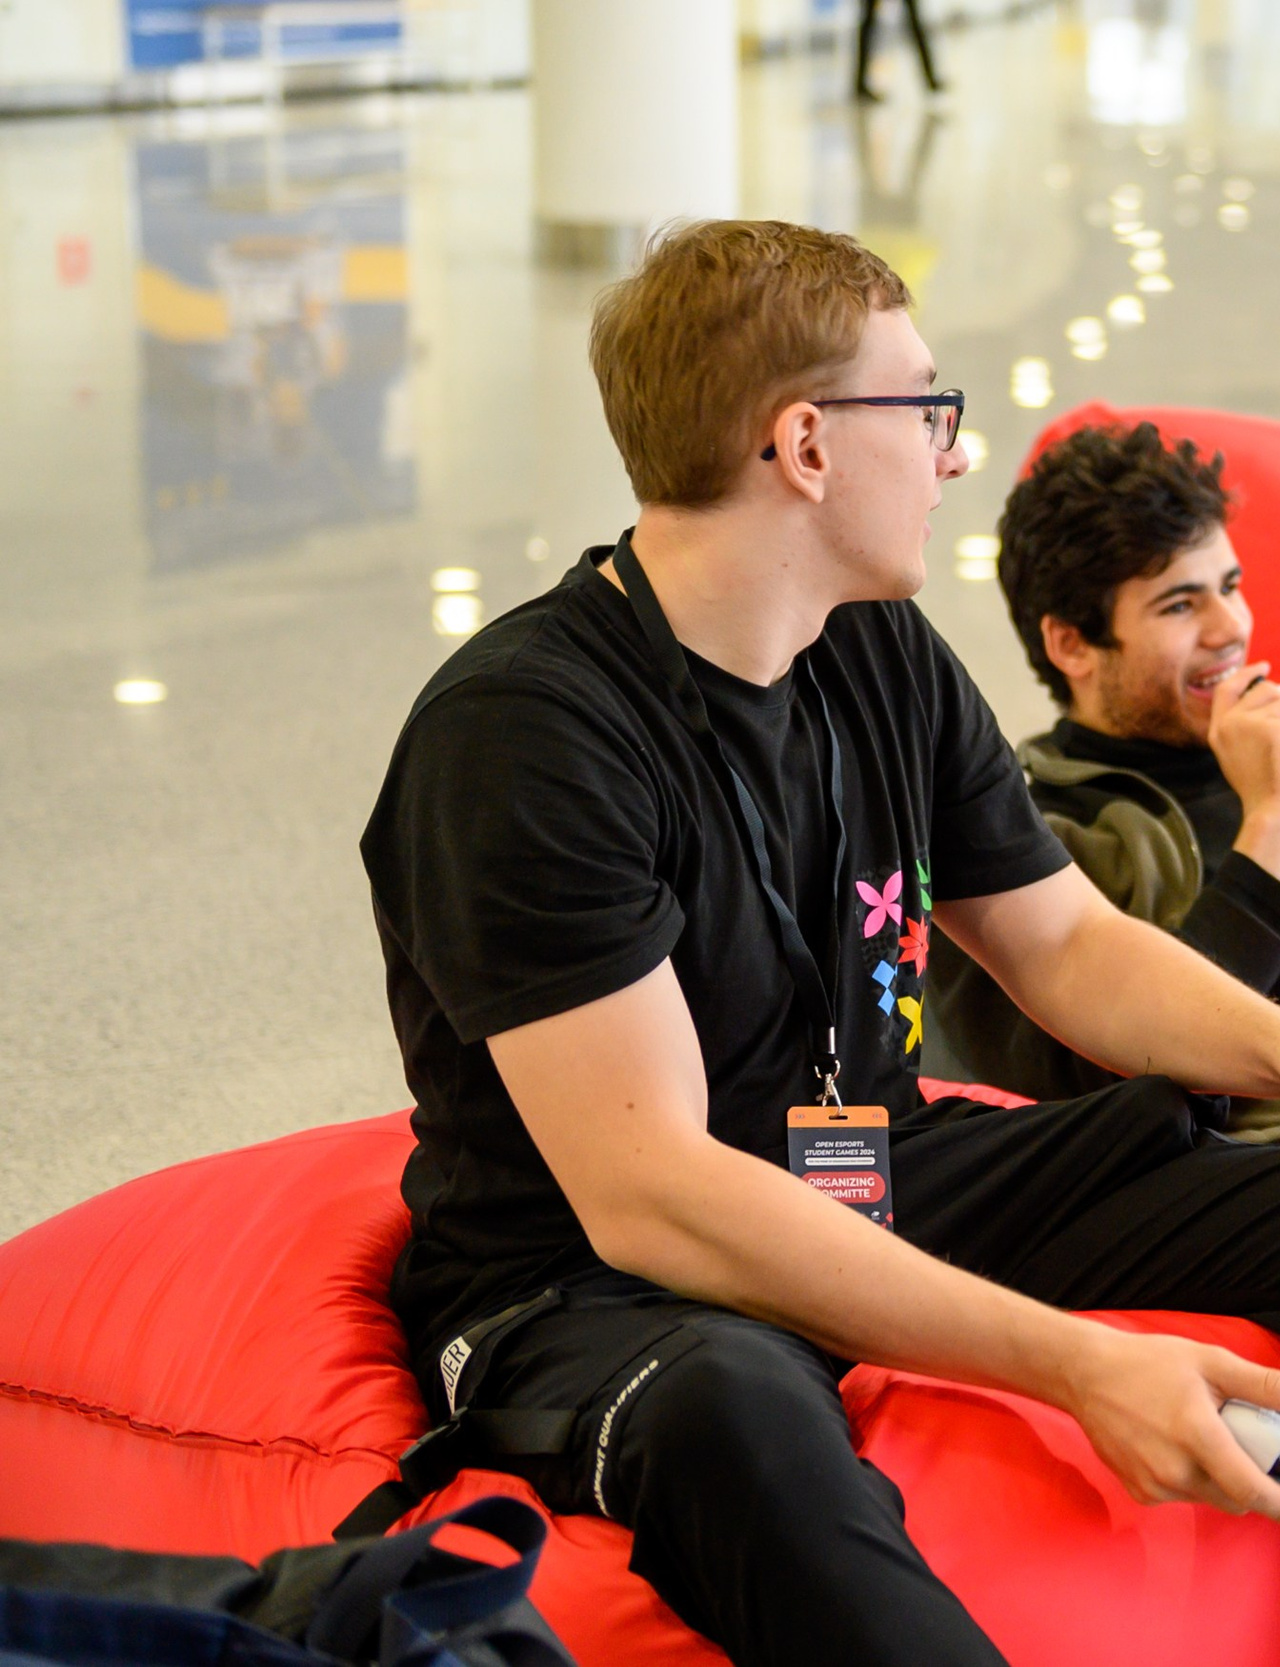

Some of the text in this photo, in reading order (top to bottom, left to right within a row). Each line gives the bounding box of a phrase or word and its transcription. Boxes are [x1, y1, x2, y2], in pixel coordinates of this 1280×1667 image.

[808, 1177, 875, 1187] ORGANIZING
[821, 1189, 870, 1198] OMMITTE
[598, 1359, 659, 1448] QUALIFIERS
